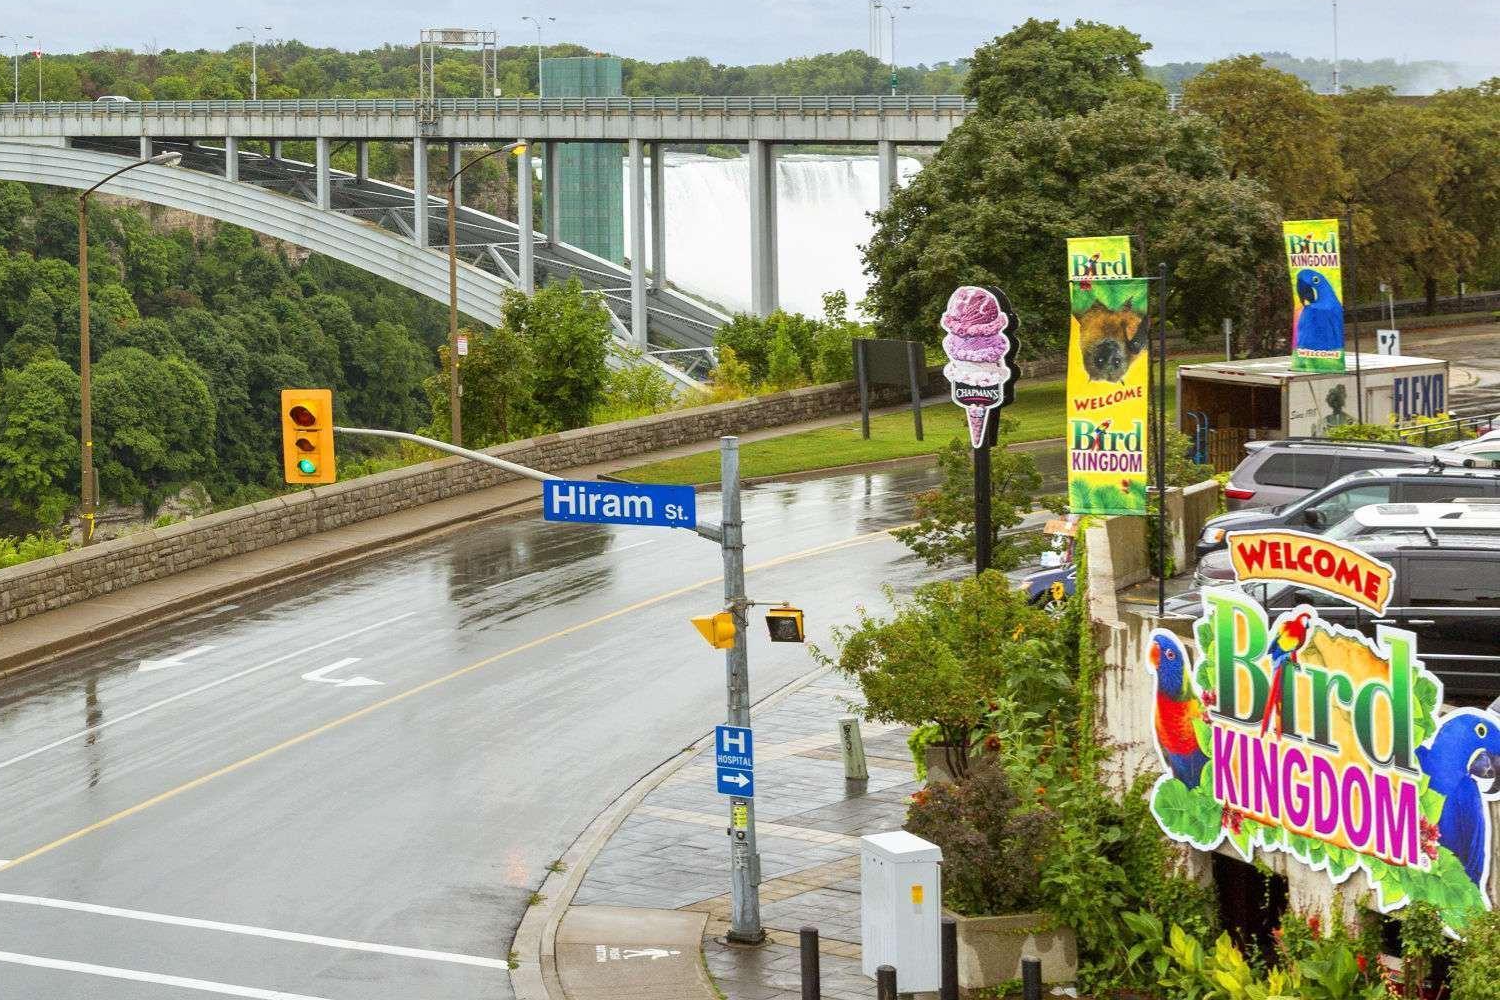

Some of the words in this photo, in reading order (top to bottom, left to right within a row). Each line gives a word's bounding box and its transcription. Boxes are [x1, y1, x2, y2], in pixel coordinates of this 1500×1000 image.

[1289, 232, 1337, 254] Bird
[1071, 252, 1129, 276] Bird
[1290, 254, 1338, 267] KINGDOM
[1297, 350, 1340, 358] WELCOME
[956, 388, 999, 400] CHAPMAN'S
[1074, 386, 1142, 411] WELCOME
[1071, 420, 1143, 452] Bird
[1072, 452, 1142, 472] KINGDOM
[552, 485, 653, 518] Hiram
[665, 503, 689, 520] St.
[1237, 539, 1383, 604] WELCOME
[1206, 594, 1420, 776] Bird
[722, 730, 746, 753] H
[717, 754, 752, 767] HOSPITAL
[1212, 726, 1420, 866] KINGDOM
